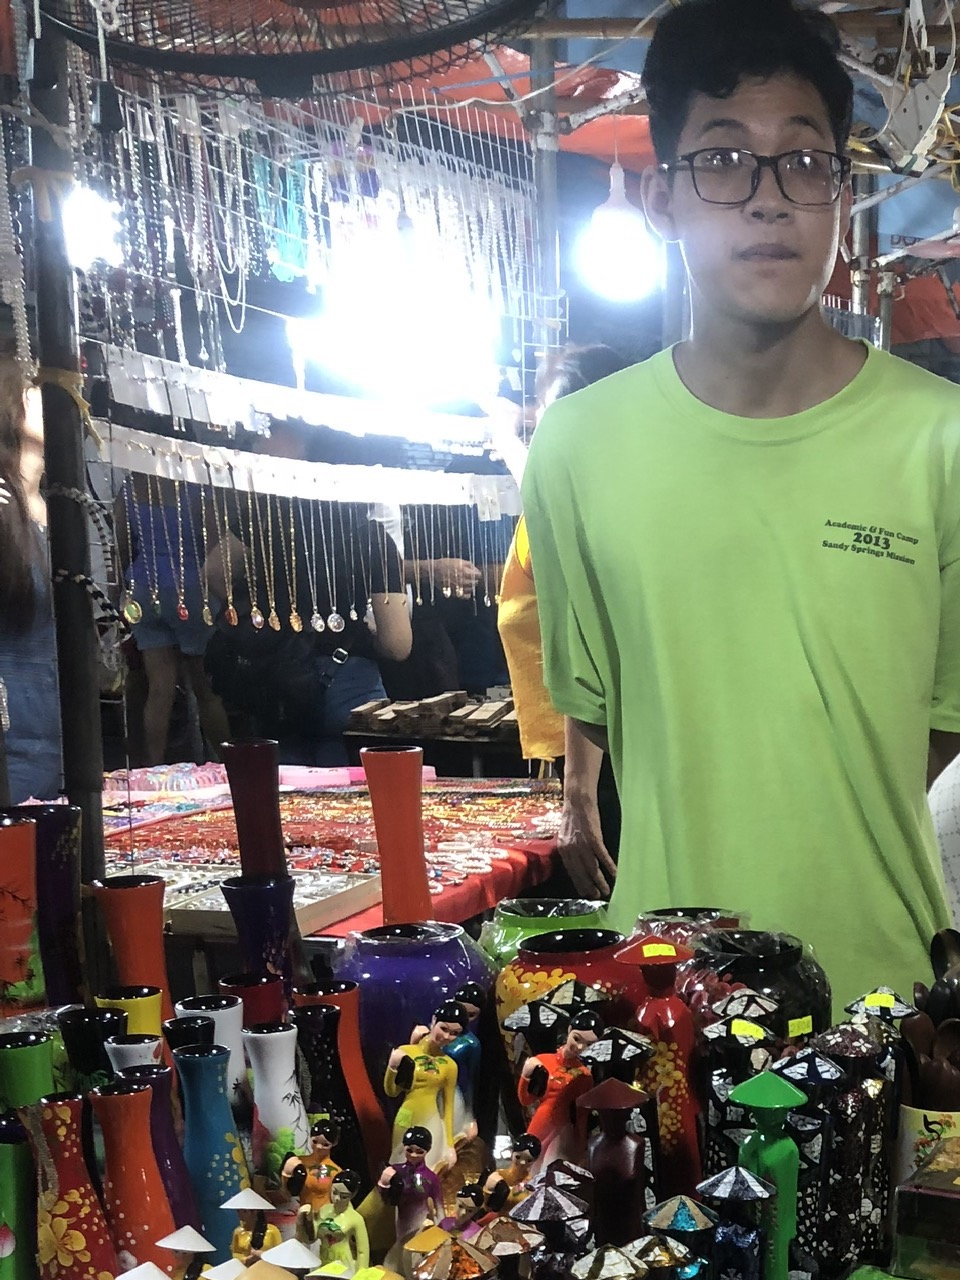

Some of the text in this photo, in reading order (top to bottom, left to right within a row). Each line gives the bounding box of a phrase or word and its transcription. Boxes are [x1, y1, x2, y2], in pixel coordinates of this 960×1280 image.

[825, 519, 867, 532] Academic
[878, 527, 895, 538] Fun
[896, 532, 919, 545] Camp
[853, 532, 891, 550] 2013
[822, 540, 915, 565] Sandy Springs Mission
